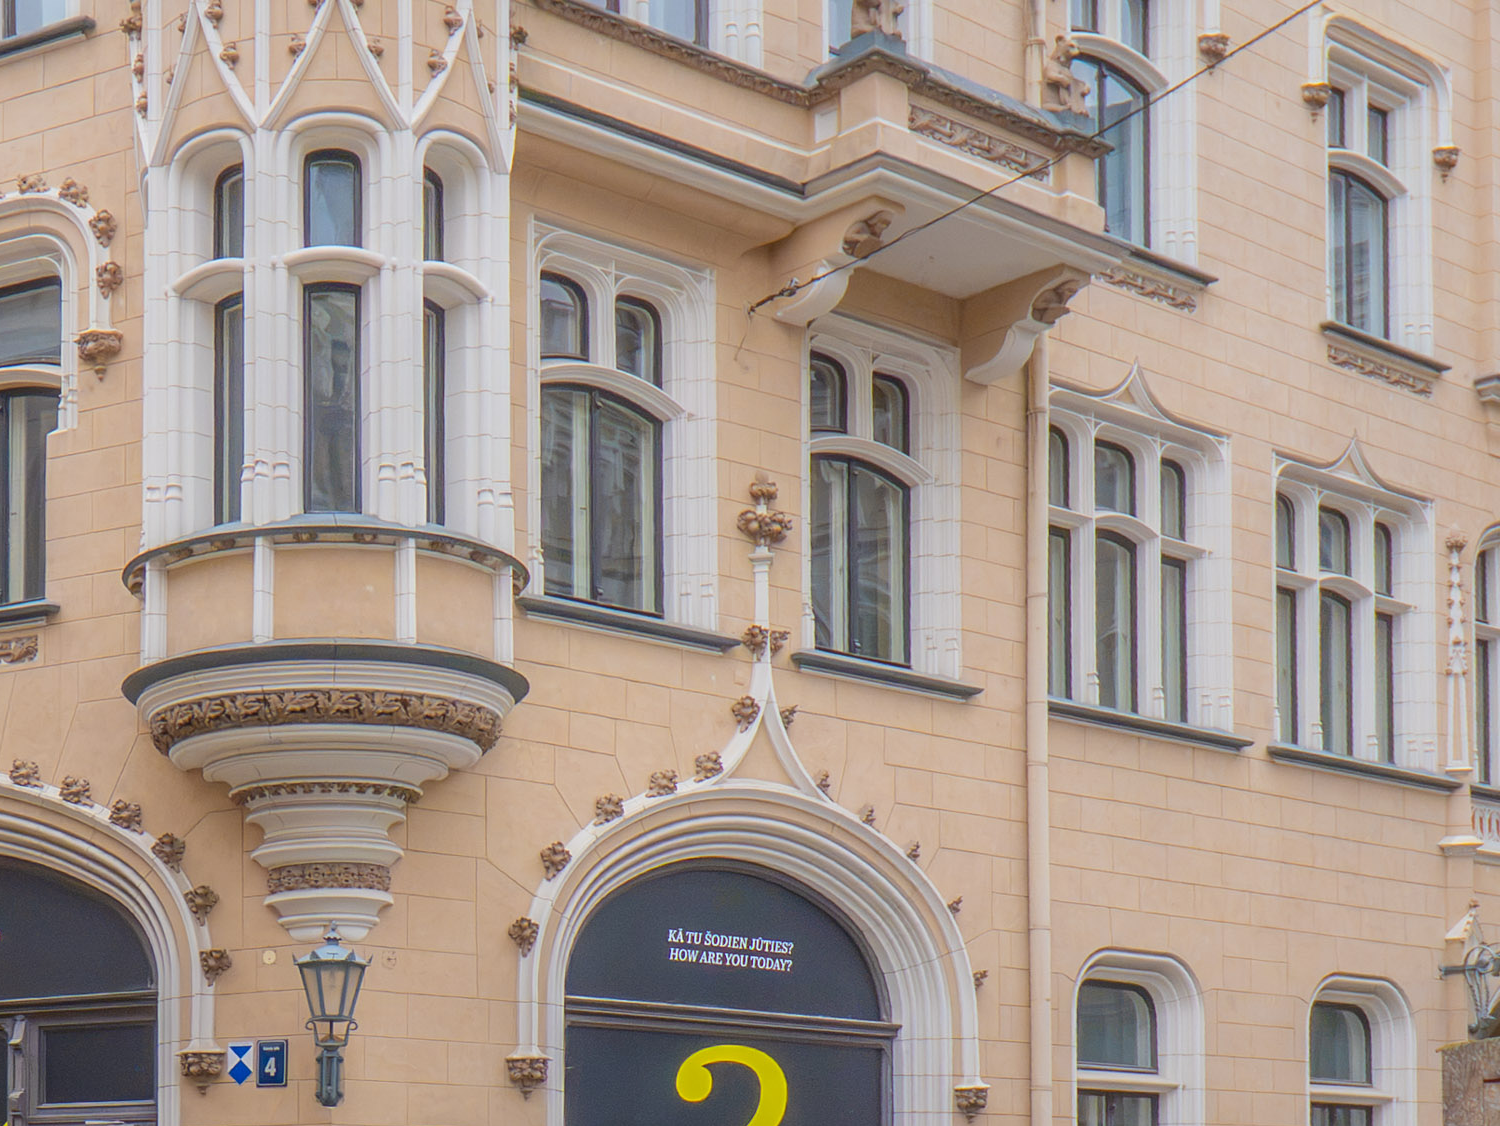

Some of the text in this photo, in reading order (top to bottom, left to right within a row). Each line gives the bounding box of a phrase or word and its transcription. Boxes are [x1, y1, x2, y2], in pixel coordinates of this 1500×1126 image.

[668, 928, 684, 943] KĀ
[686, 931, 702, 945] TU
[704, 931, 748, 950] ŠODIEN
[669, 947, 792, 971] HOW ARE YOU TODAY?
[265, 1057, 276, 1077] 4
